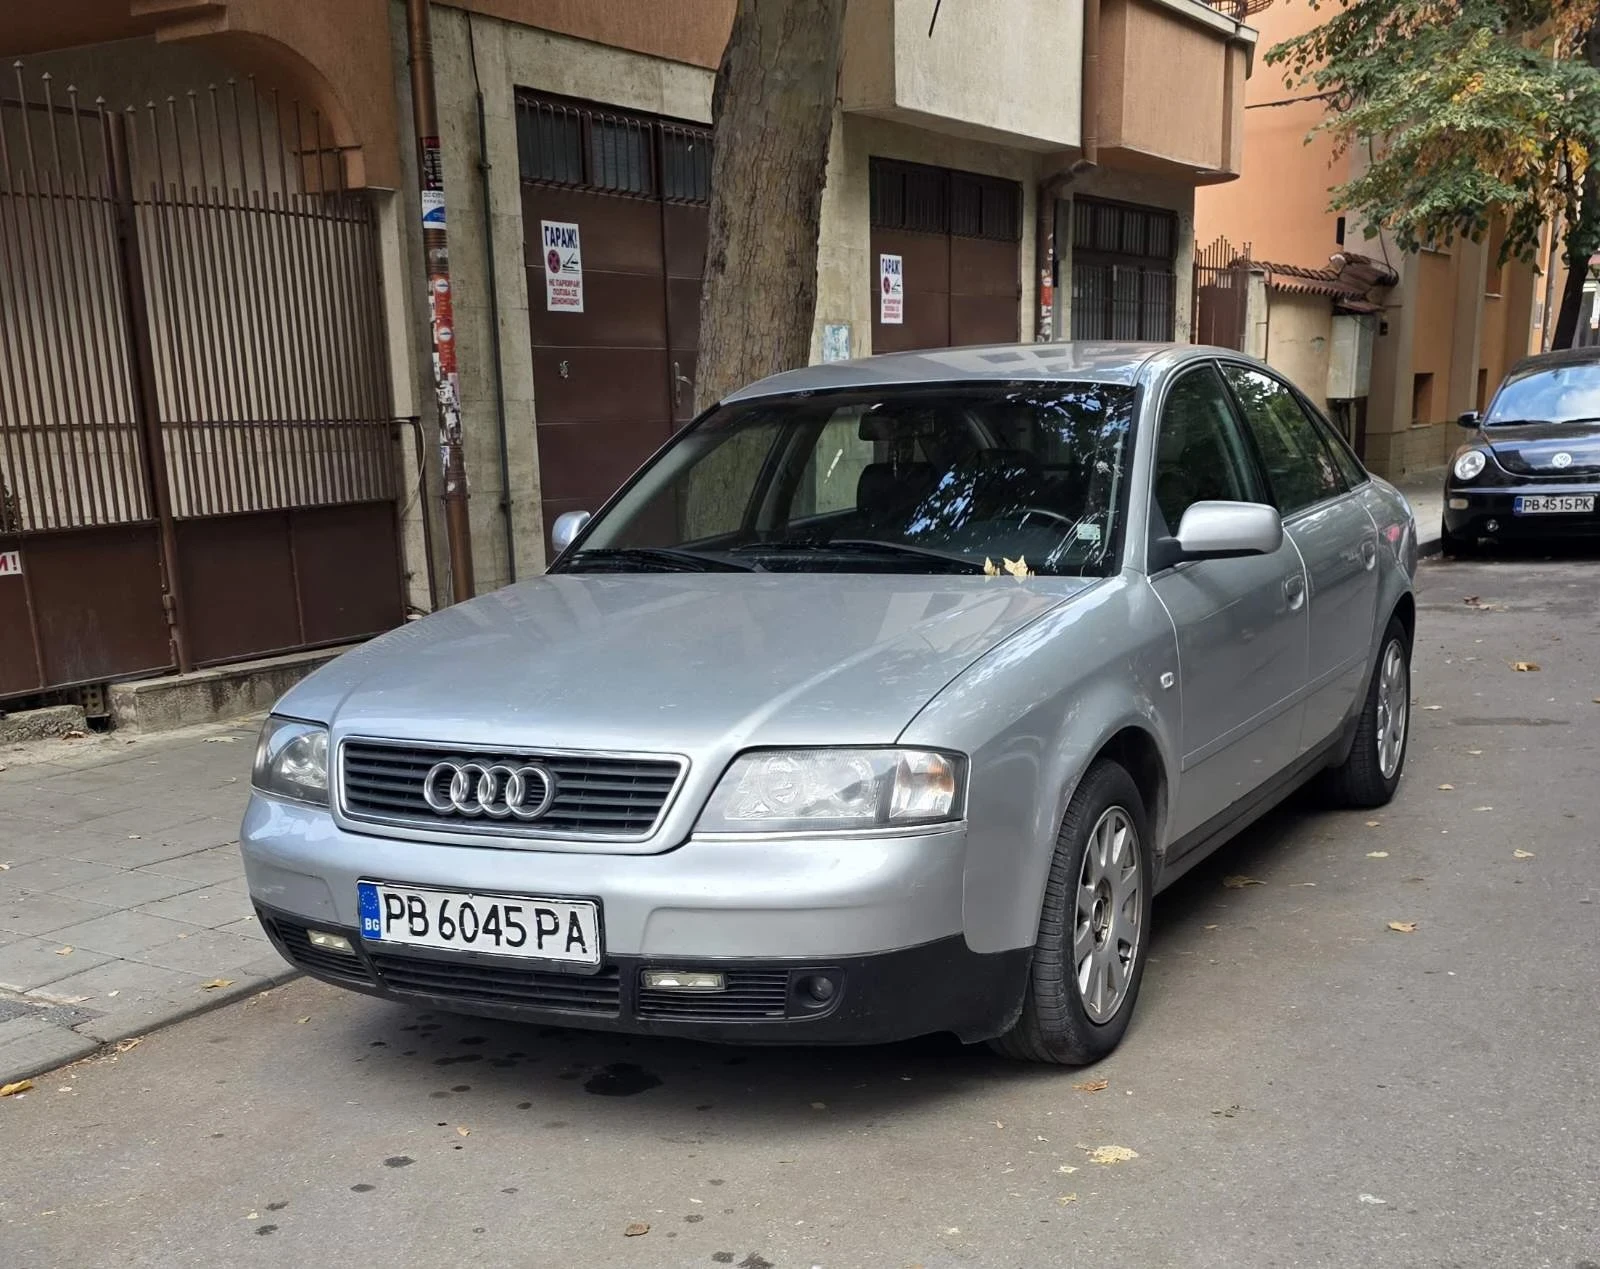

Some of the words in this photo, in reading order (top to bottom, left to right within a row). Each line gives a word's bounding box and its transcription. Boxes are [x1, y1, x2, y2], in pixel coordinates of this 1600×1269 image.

[544, 225, 578, 249] ГАРАЖ!
[1523, 499, 1540, 511] PB
[1574, 498, 1591, 510] PK
[364, 917, 380, 932] BG
[383, 892, 430, 937] PB
[438, 899, 527, 948] 6045
[534, 907, 588, 954] PA
